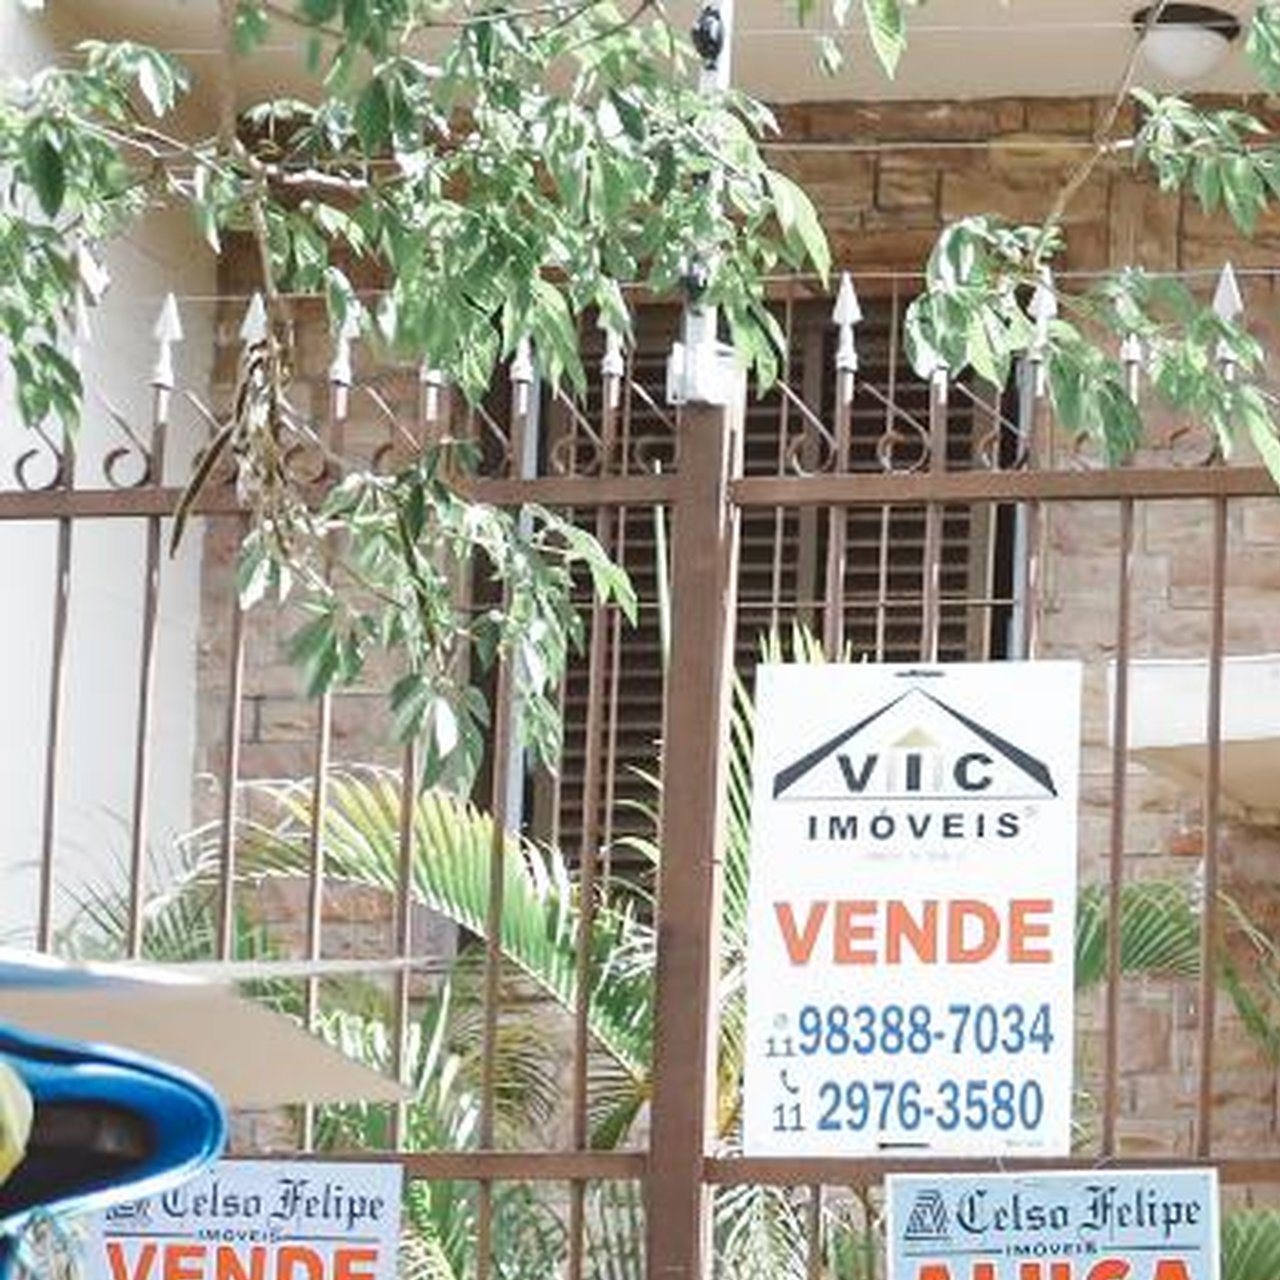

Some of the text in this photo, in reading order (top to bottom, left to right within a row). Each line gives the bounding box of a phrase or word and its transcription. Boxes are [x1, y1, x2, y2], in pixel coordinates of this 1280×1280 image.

[837, 753, 993, 793] VIC
[808, 807, 1020, 840] IMÓVEIS
[774, 899, 1053, 965] VENDE
[799, 1003, 1054, 1054] 98388-7034
[817, 1080, 1044, 1131] 2976-3580
[270, 1178, 385, 1230] Felipe
[956, 1185, 1201, 1240] Celso Felipe
